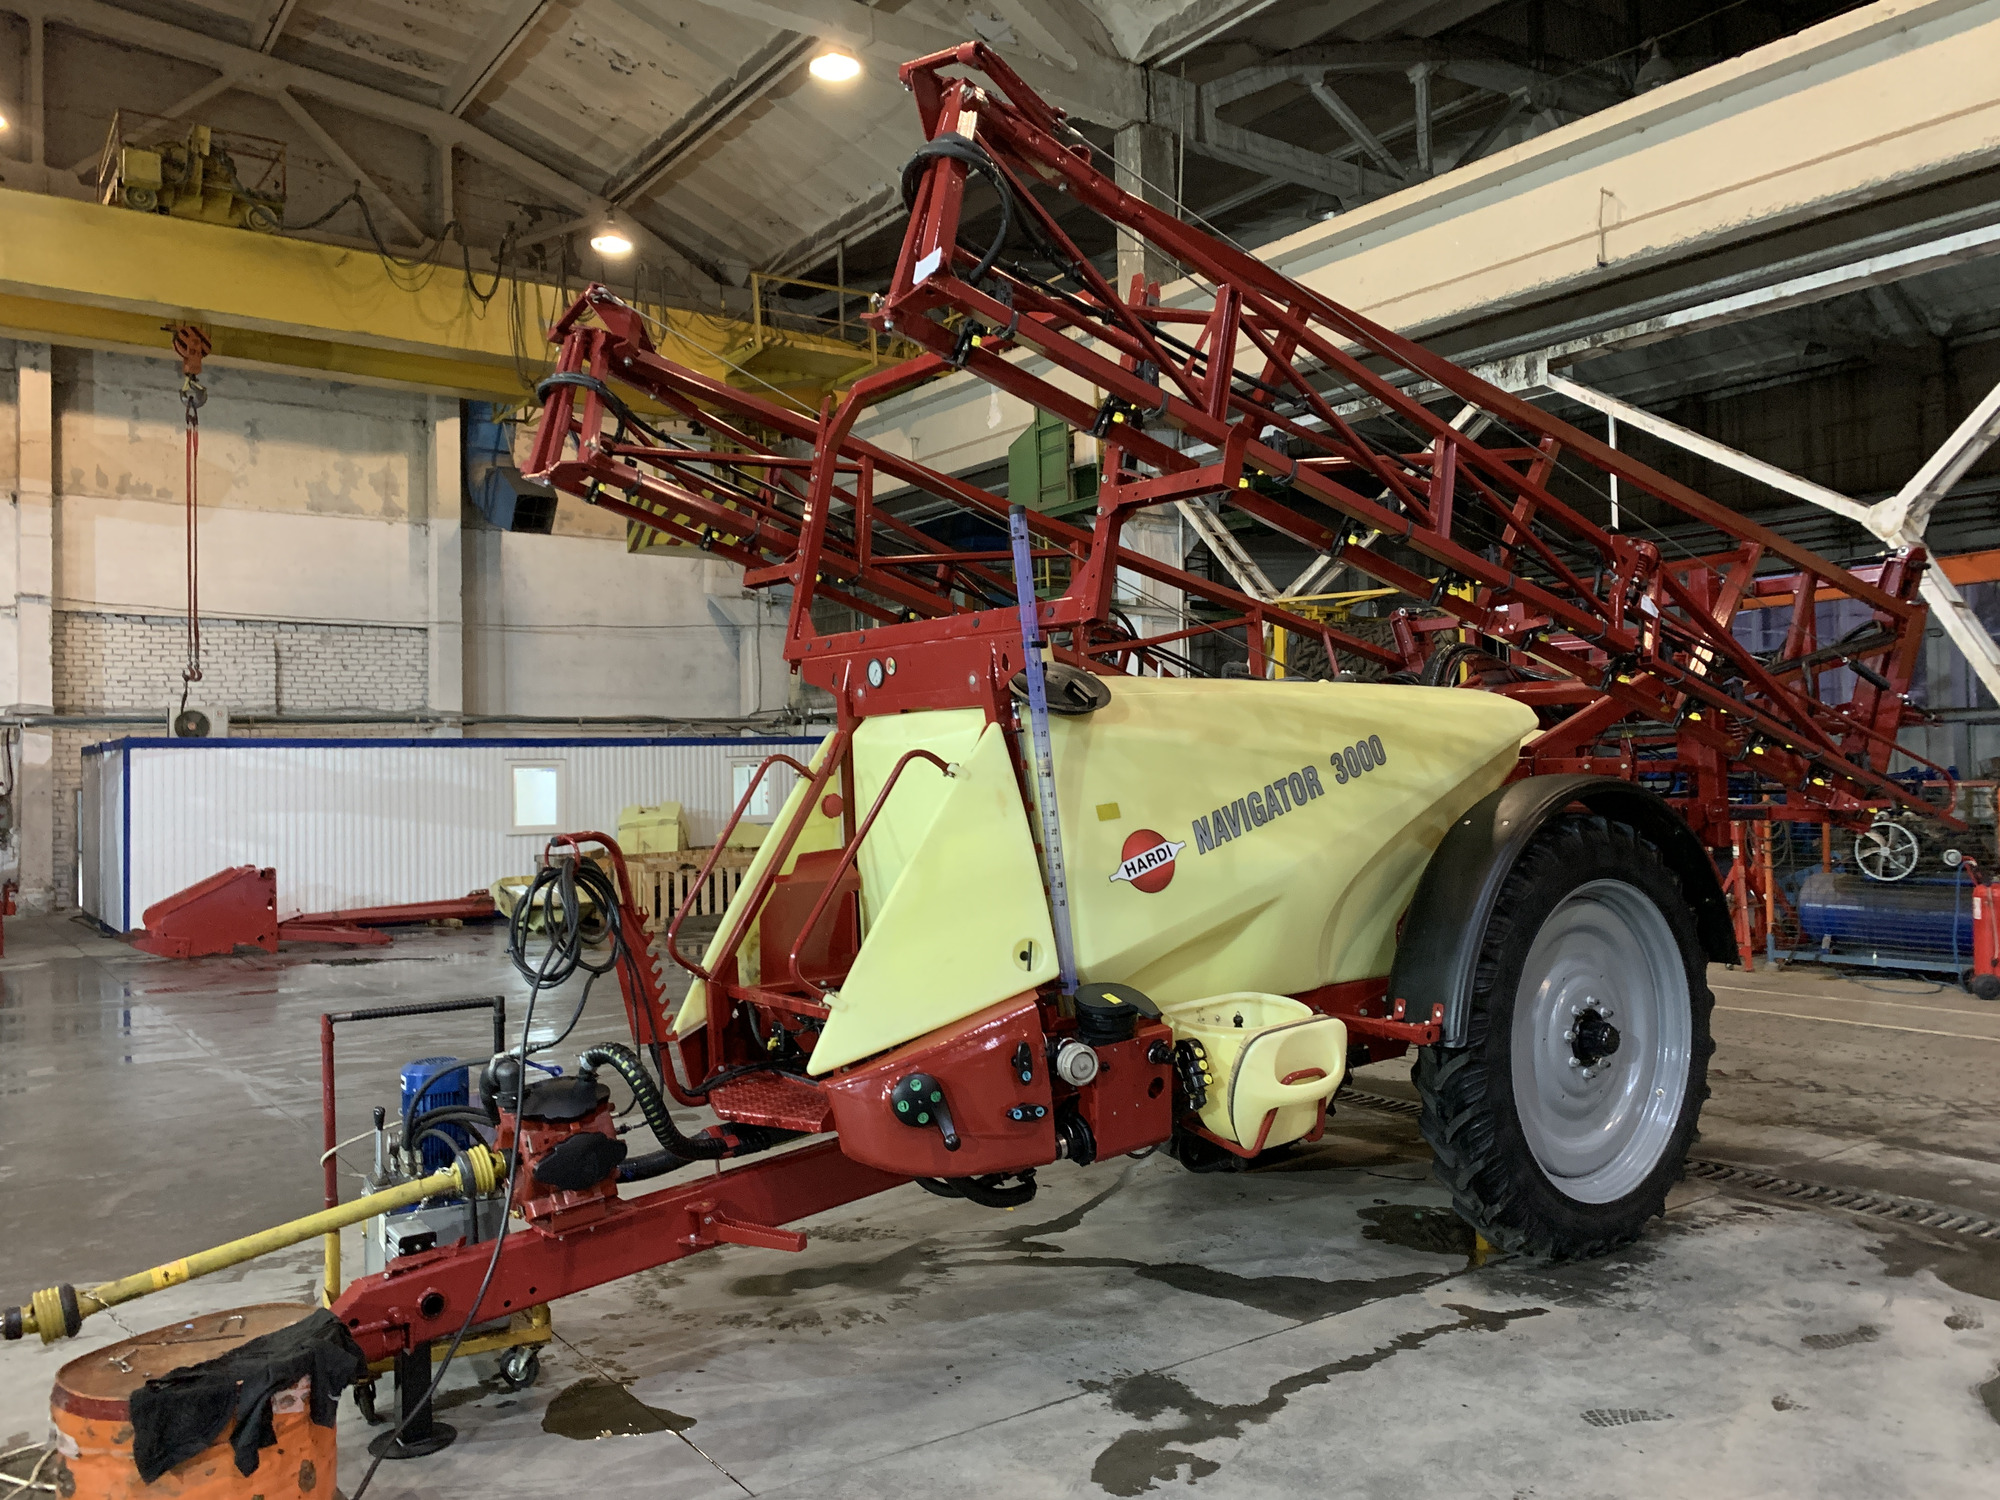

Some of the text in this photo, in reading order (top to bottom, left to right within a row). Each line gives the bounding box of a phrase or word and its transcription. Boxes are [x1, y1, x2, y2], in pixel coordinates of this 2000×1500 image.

[1040, 730, 1047, 738] 12
[1191, 734, 1386, 855] NAVIGATOR 3000
[1124, 844, 1173, 877] HARDI
